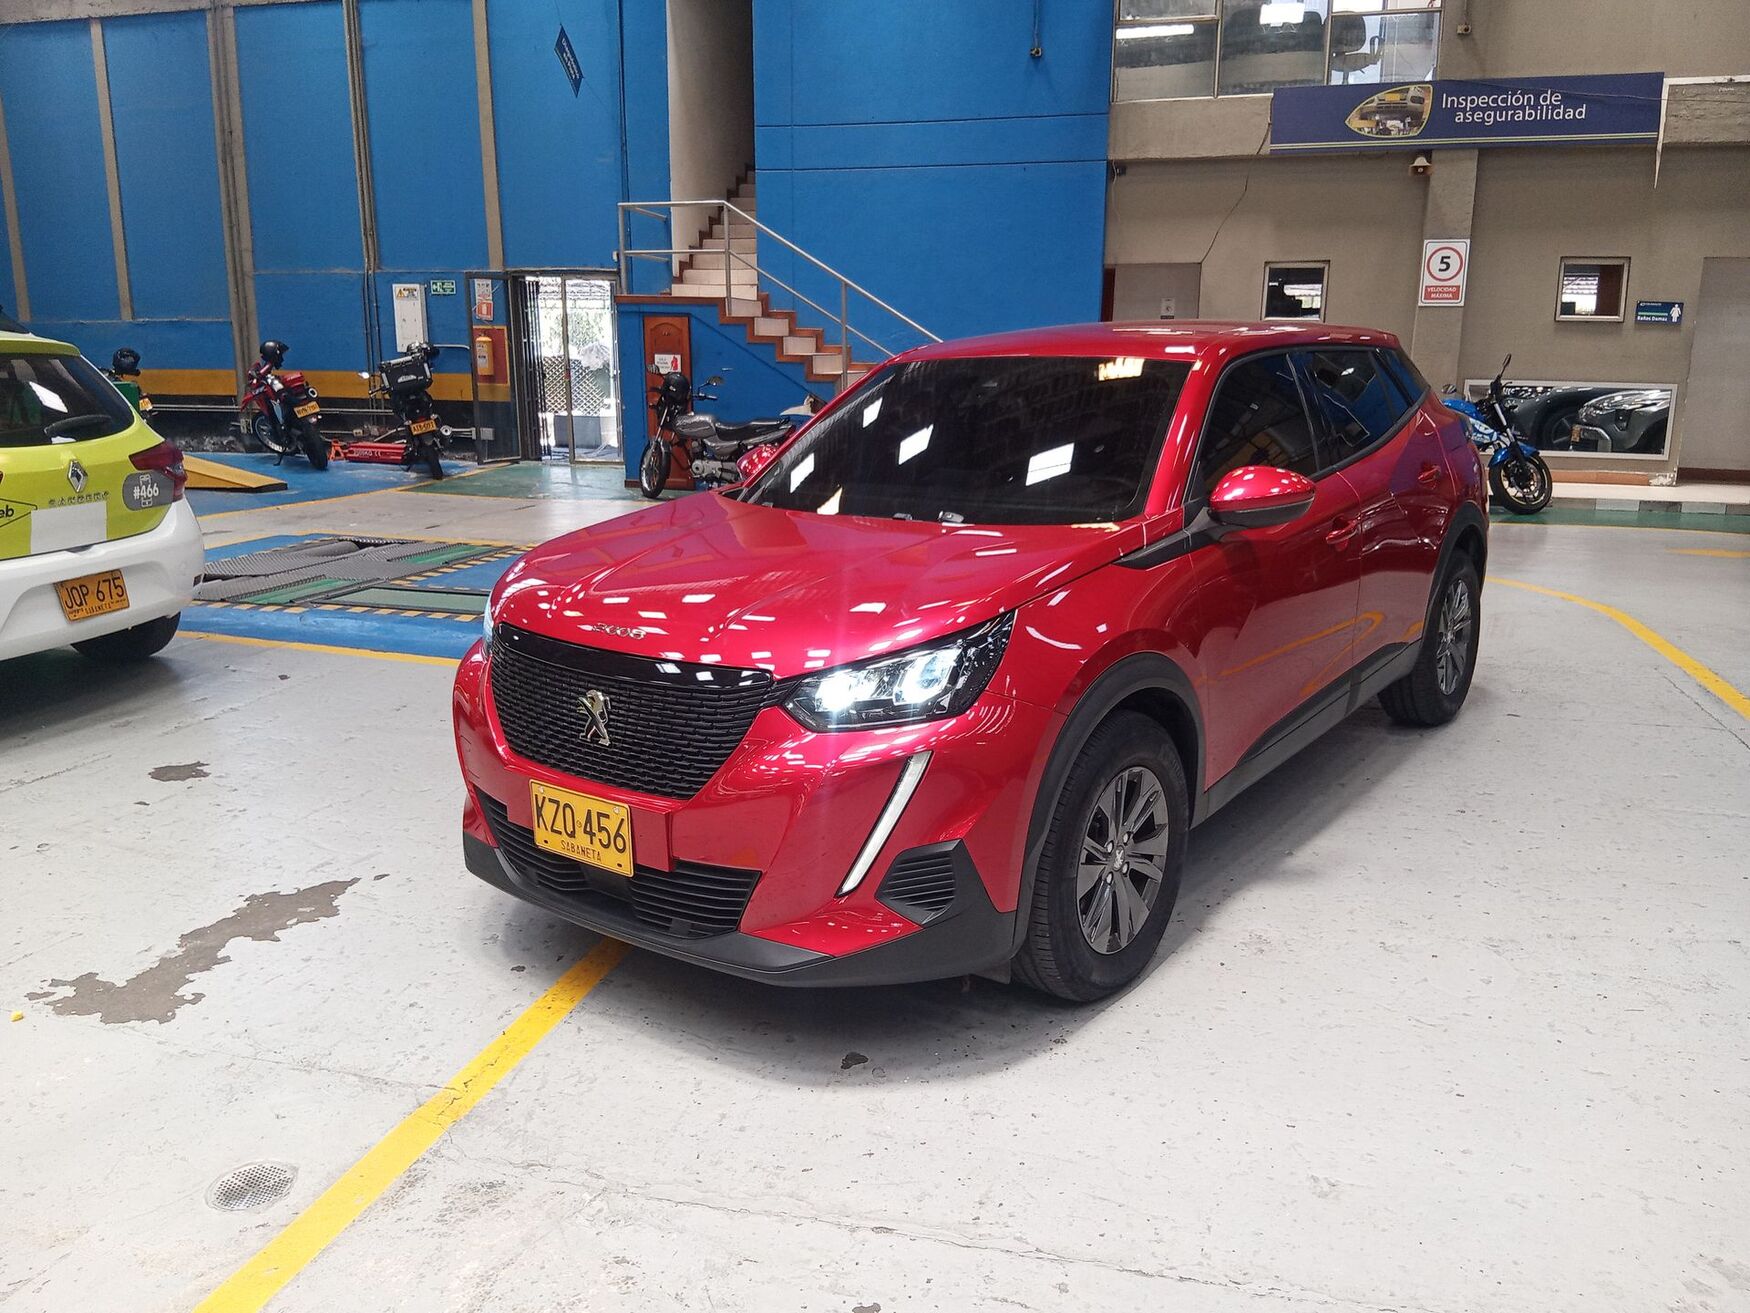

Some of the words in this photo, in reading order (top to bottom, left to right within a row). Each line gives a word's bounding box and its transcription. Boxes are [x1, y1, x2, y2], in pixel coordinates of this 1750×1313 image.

[1442, 90, 1534, 110] Inspección
[1539, 88, 1562, 105] de
[1455, 104, 1586, 125] asegurabilidad
[1438, 256, 1451, 272] 5
[133, 484, 159, 499] #466
[65, 584, 90, 609] JQP
[96, 576, 125, 602] 675
[534, 793, 576, 839] KZQ
[583, 808, 627, 854] 456
[561, 839, 602, 862] SABANETA
